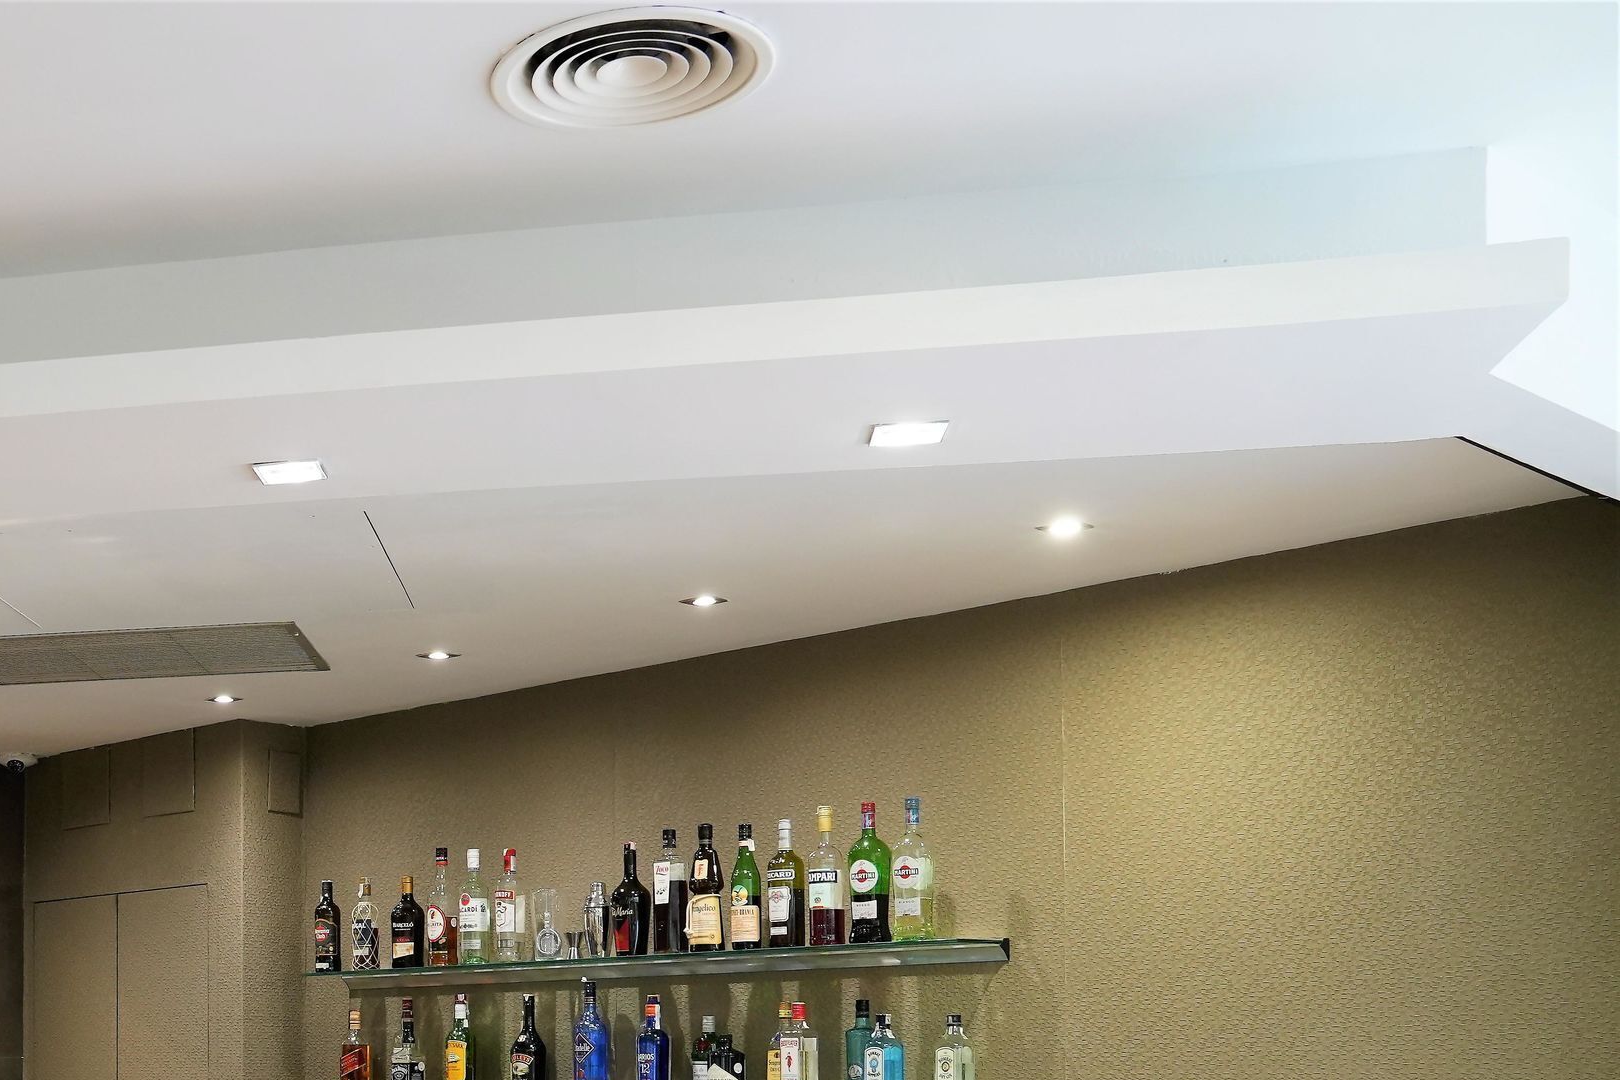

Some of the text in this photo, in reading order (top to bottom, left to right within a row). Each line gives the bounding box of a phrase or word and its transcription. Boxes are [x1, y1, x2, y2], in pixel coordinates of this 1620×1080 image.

[768, 871, 792, 879] CARD
[851, 871, 876, 880] MARTINI
[894, 867, 919, 876] MARTINI
[808, 871, 836, 882] AMPARI
[460, 905, 478, 913] CARDÍ
[638, 1053, 655, 1062] ARIOS
[640, 1063, 650, 1074] 12
